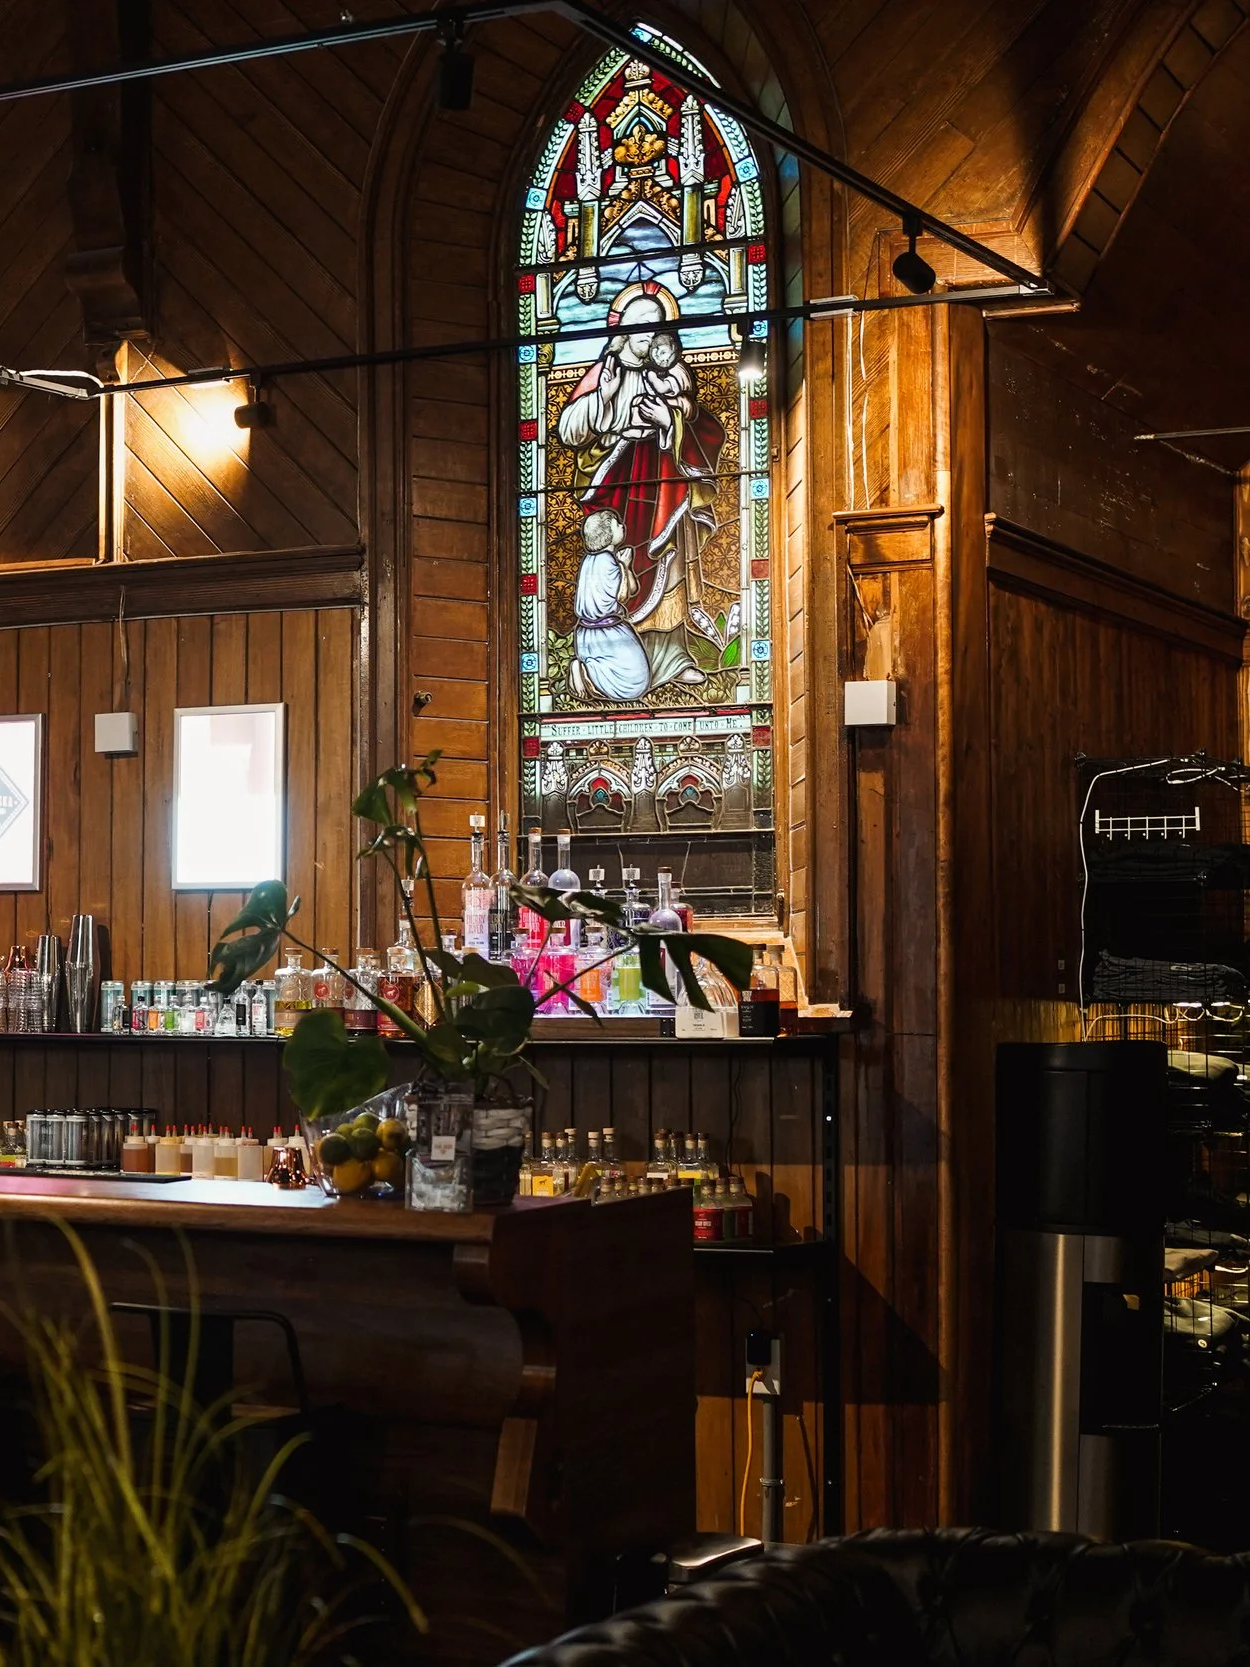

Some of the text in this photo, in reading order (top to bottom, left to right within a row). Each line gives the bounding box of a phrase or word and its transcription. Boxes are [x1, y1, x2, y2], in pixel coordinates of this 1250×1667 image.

[587, 724, 614, 735] LITTLE
[618, 722, 653, 734] CHILDREN
[659, 722, 668, 732] TO
[673, 721, 691, 731] COME
[699, 720, 719, 731] UNTO
